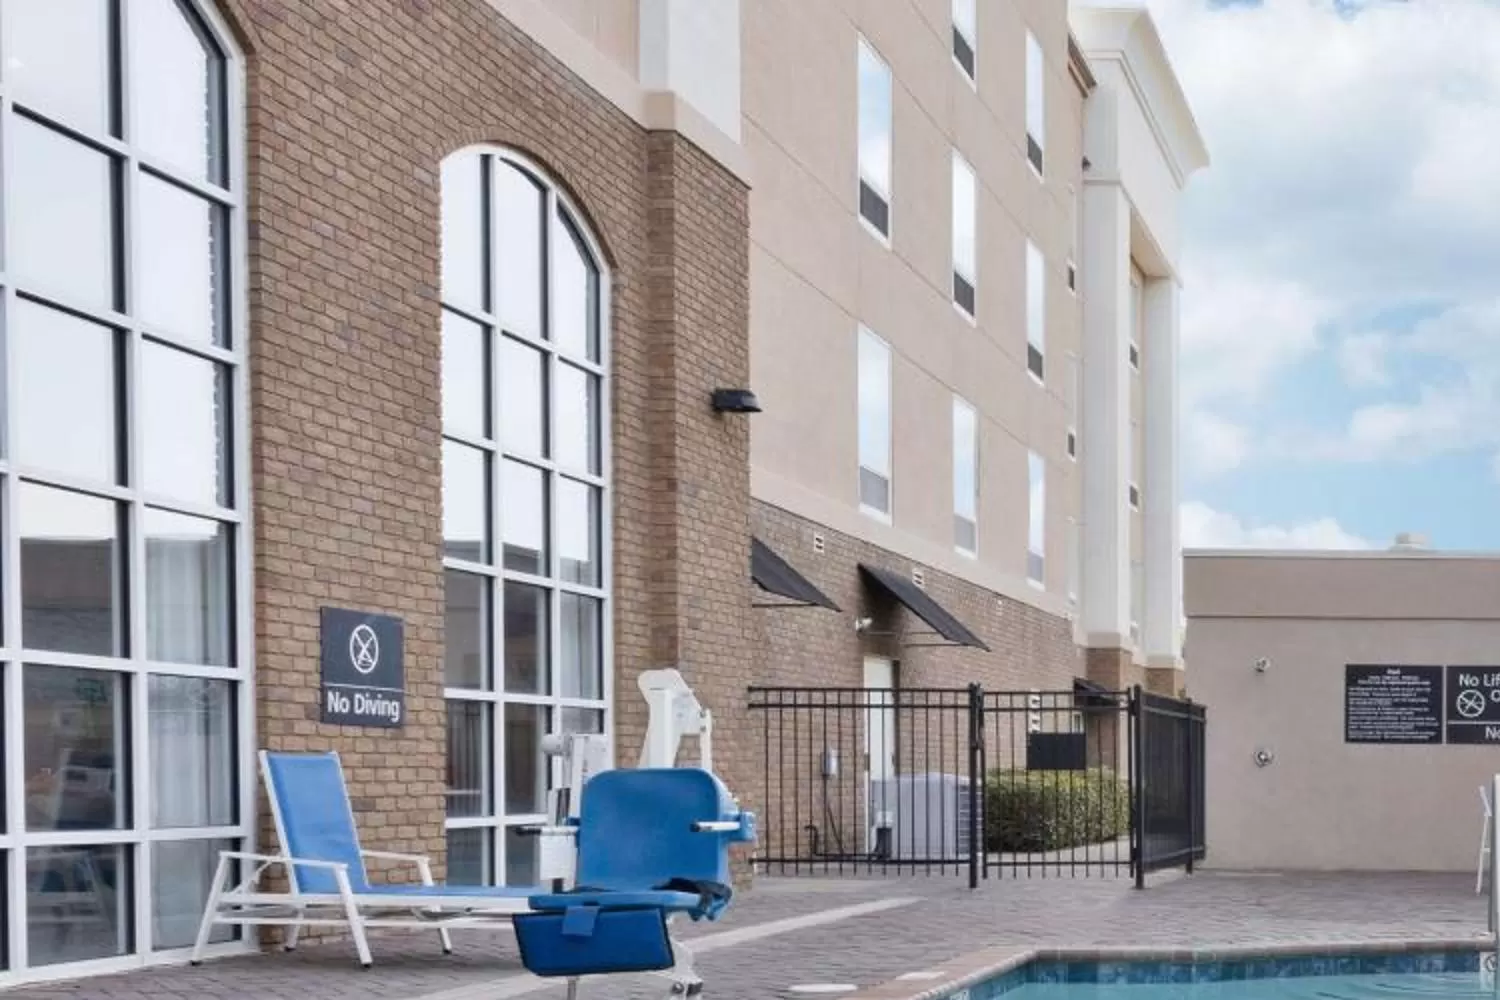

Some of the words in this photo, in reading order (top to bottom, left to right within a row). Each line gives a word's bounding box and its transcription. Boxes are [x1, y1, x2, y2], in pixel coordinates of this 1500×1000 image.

[1459, 674, 1480, 687] No
[327, 690, 350, 713] No
[353, 693, 400, 723] Diving
